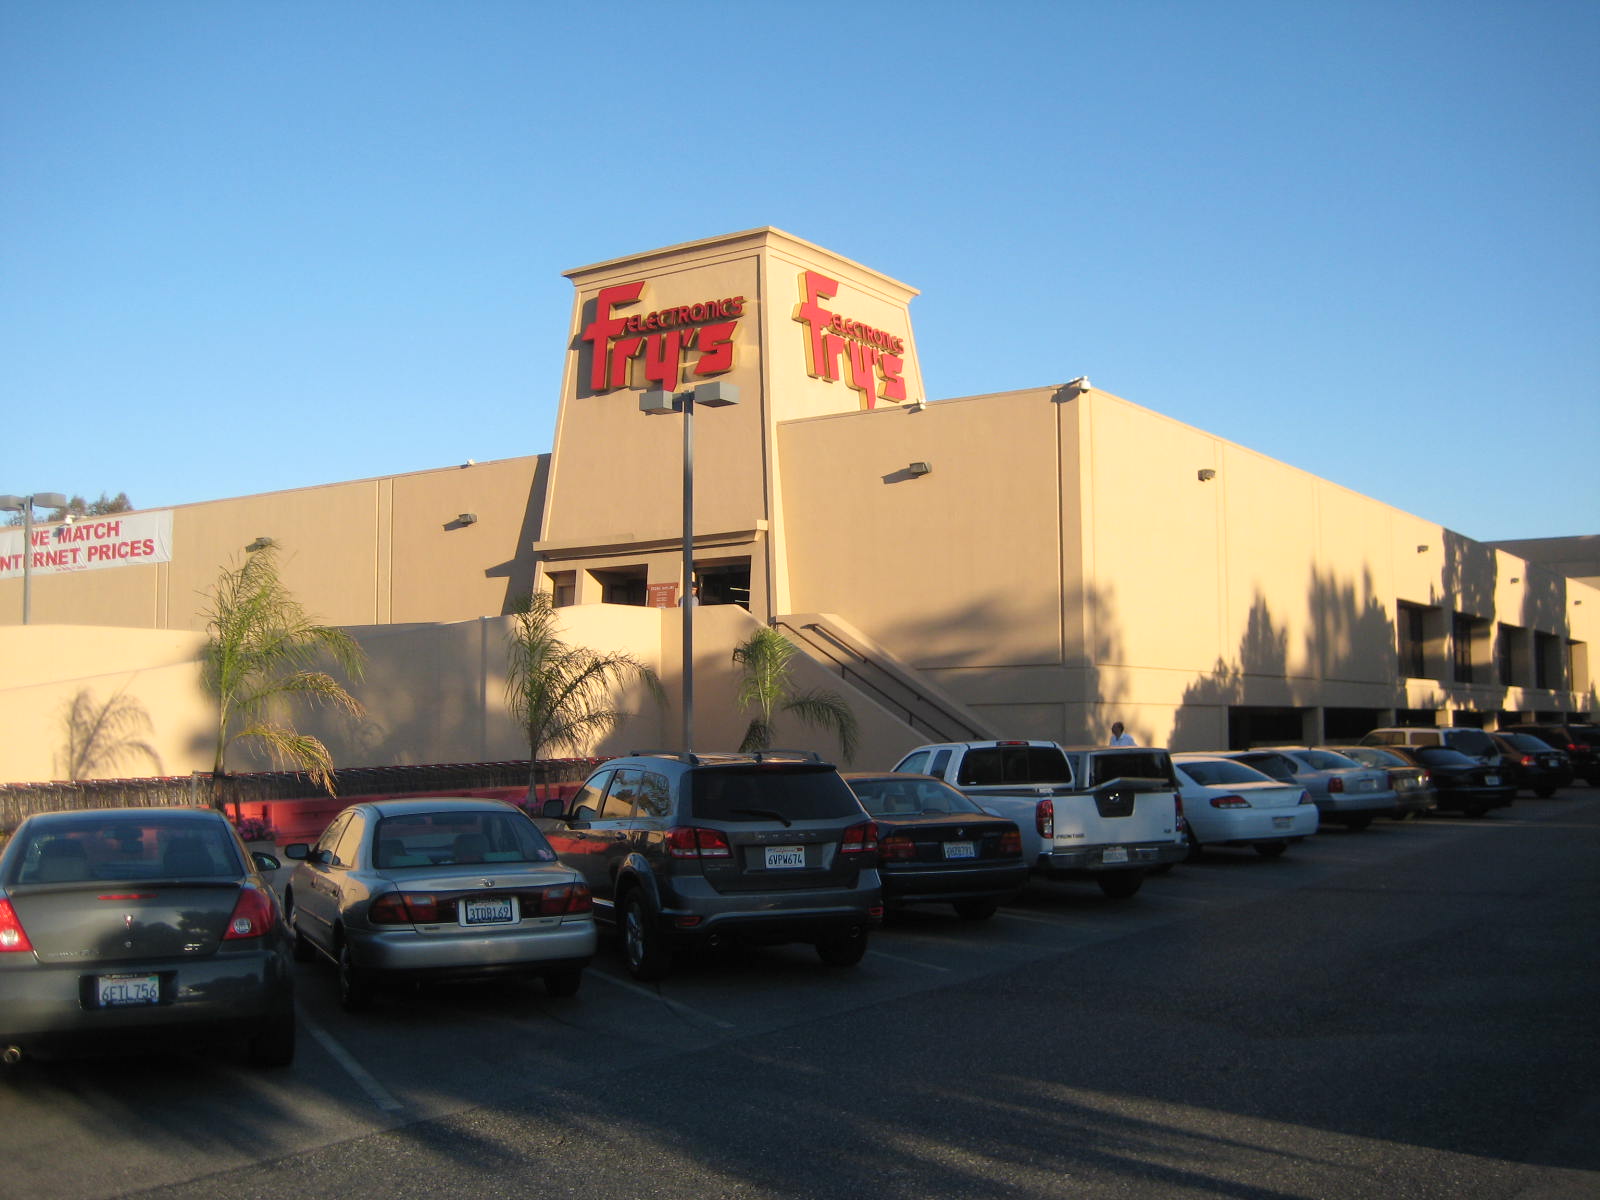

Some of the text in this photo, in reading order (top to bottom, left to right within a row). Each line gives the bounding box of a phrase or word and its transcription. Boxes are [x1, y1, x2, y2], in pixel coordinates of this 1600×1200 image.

[57, 520, 121, 545] MATCH
[87, 538, 155, 562] PRICES
[767, 853, 803, 865] 6VPW674
